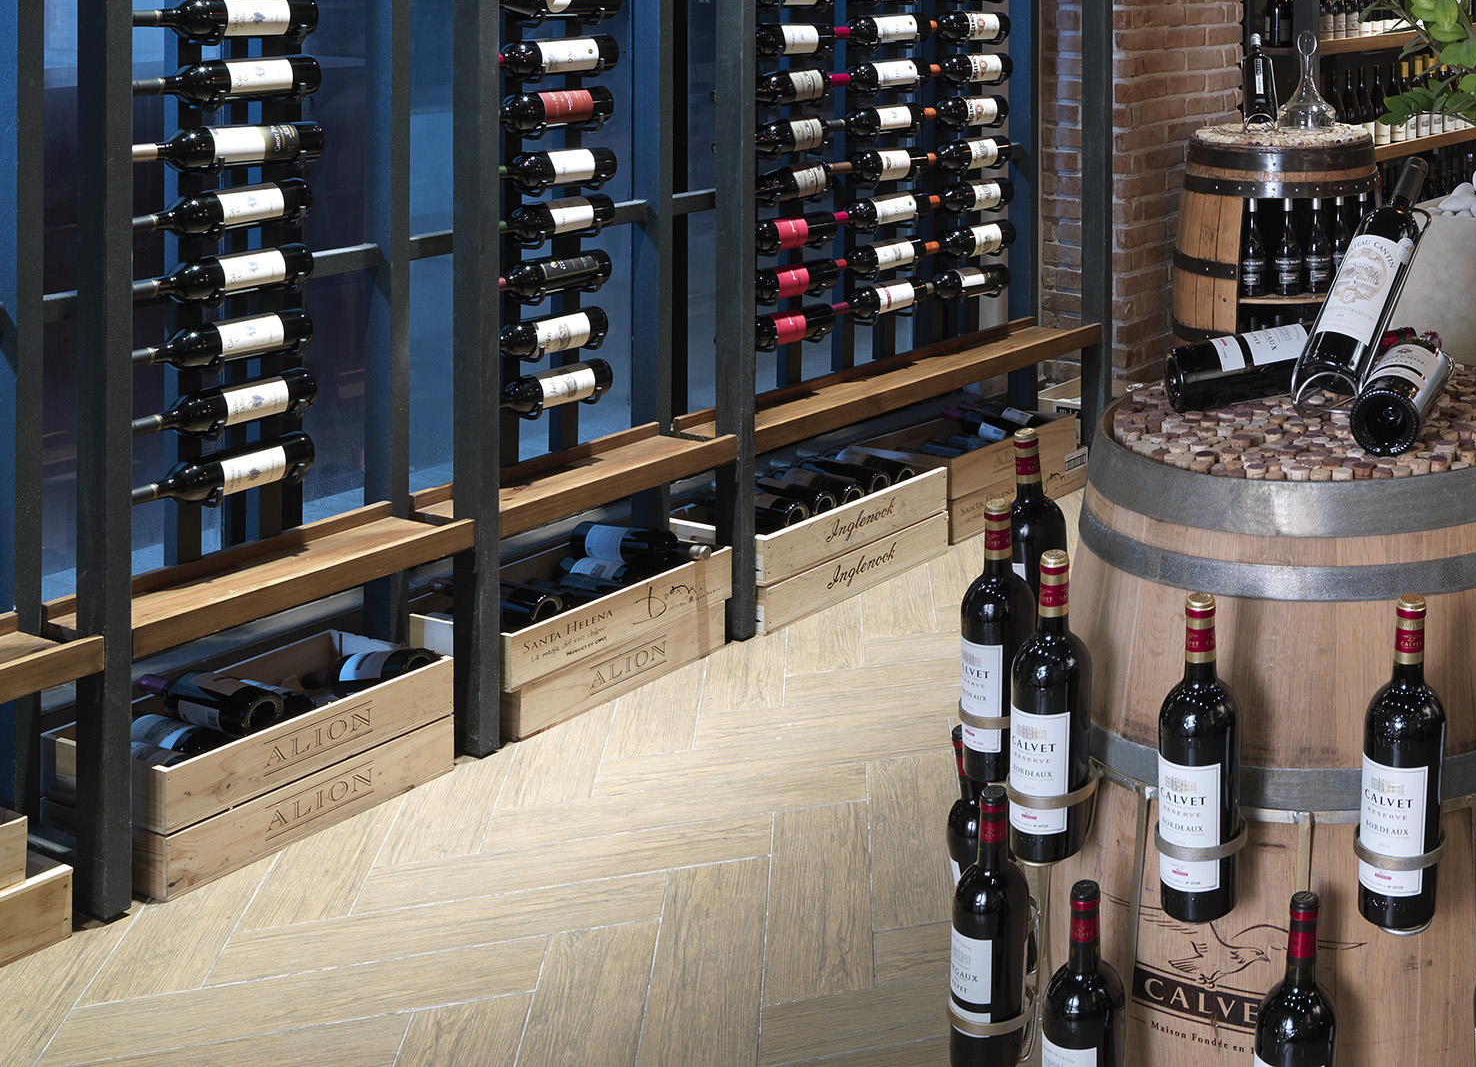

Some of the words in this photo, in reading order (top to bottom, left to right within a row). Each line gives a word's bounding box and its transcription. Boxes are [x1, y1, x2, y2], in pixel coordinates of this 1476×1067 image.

[1373, 241, 1395, 269] CANTIN
[825, 496, 896, 543] Inglenook
[827, 542, 896, 590] Inglenook
[523, 632, 561, 654] SANTA
[566, 610, 613, 635] HELENA
[589, 640, 667, 691] ALION
[962, 662, 990, 679] ALVET
[263, 707, 374, 770] ALION
[1012, 735, 1056, 753] CALVET
[1014, 752, 1051, 764] RESERVE
[1013, 764, 1053, 778] BORDEAUX
[265, 767, 375, 834] ALION
[1160, 787, 1207, 806] CALVET
[1364, 789, 1414, 809] CALVET
[1163, 804, 1201, 818] RESERVE
[1367, 807, 1408, 821] RESERVE
[1162, 817, 1203, 832] BORDEAUX
[1366, 819, 1409, 836] BORDEAUX
[1144, 977, 1259, 1024] CALVE
[1150, 1020, 1188, 1039] Maison
[1191, 1033, 1229, 1049] Fondée
[1232, 1044, 1245, 1053] en
